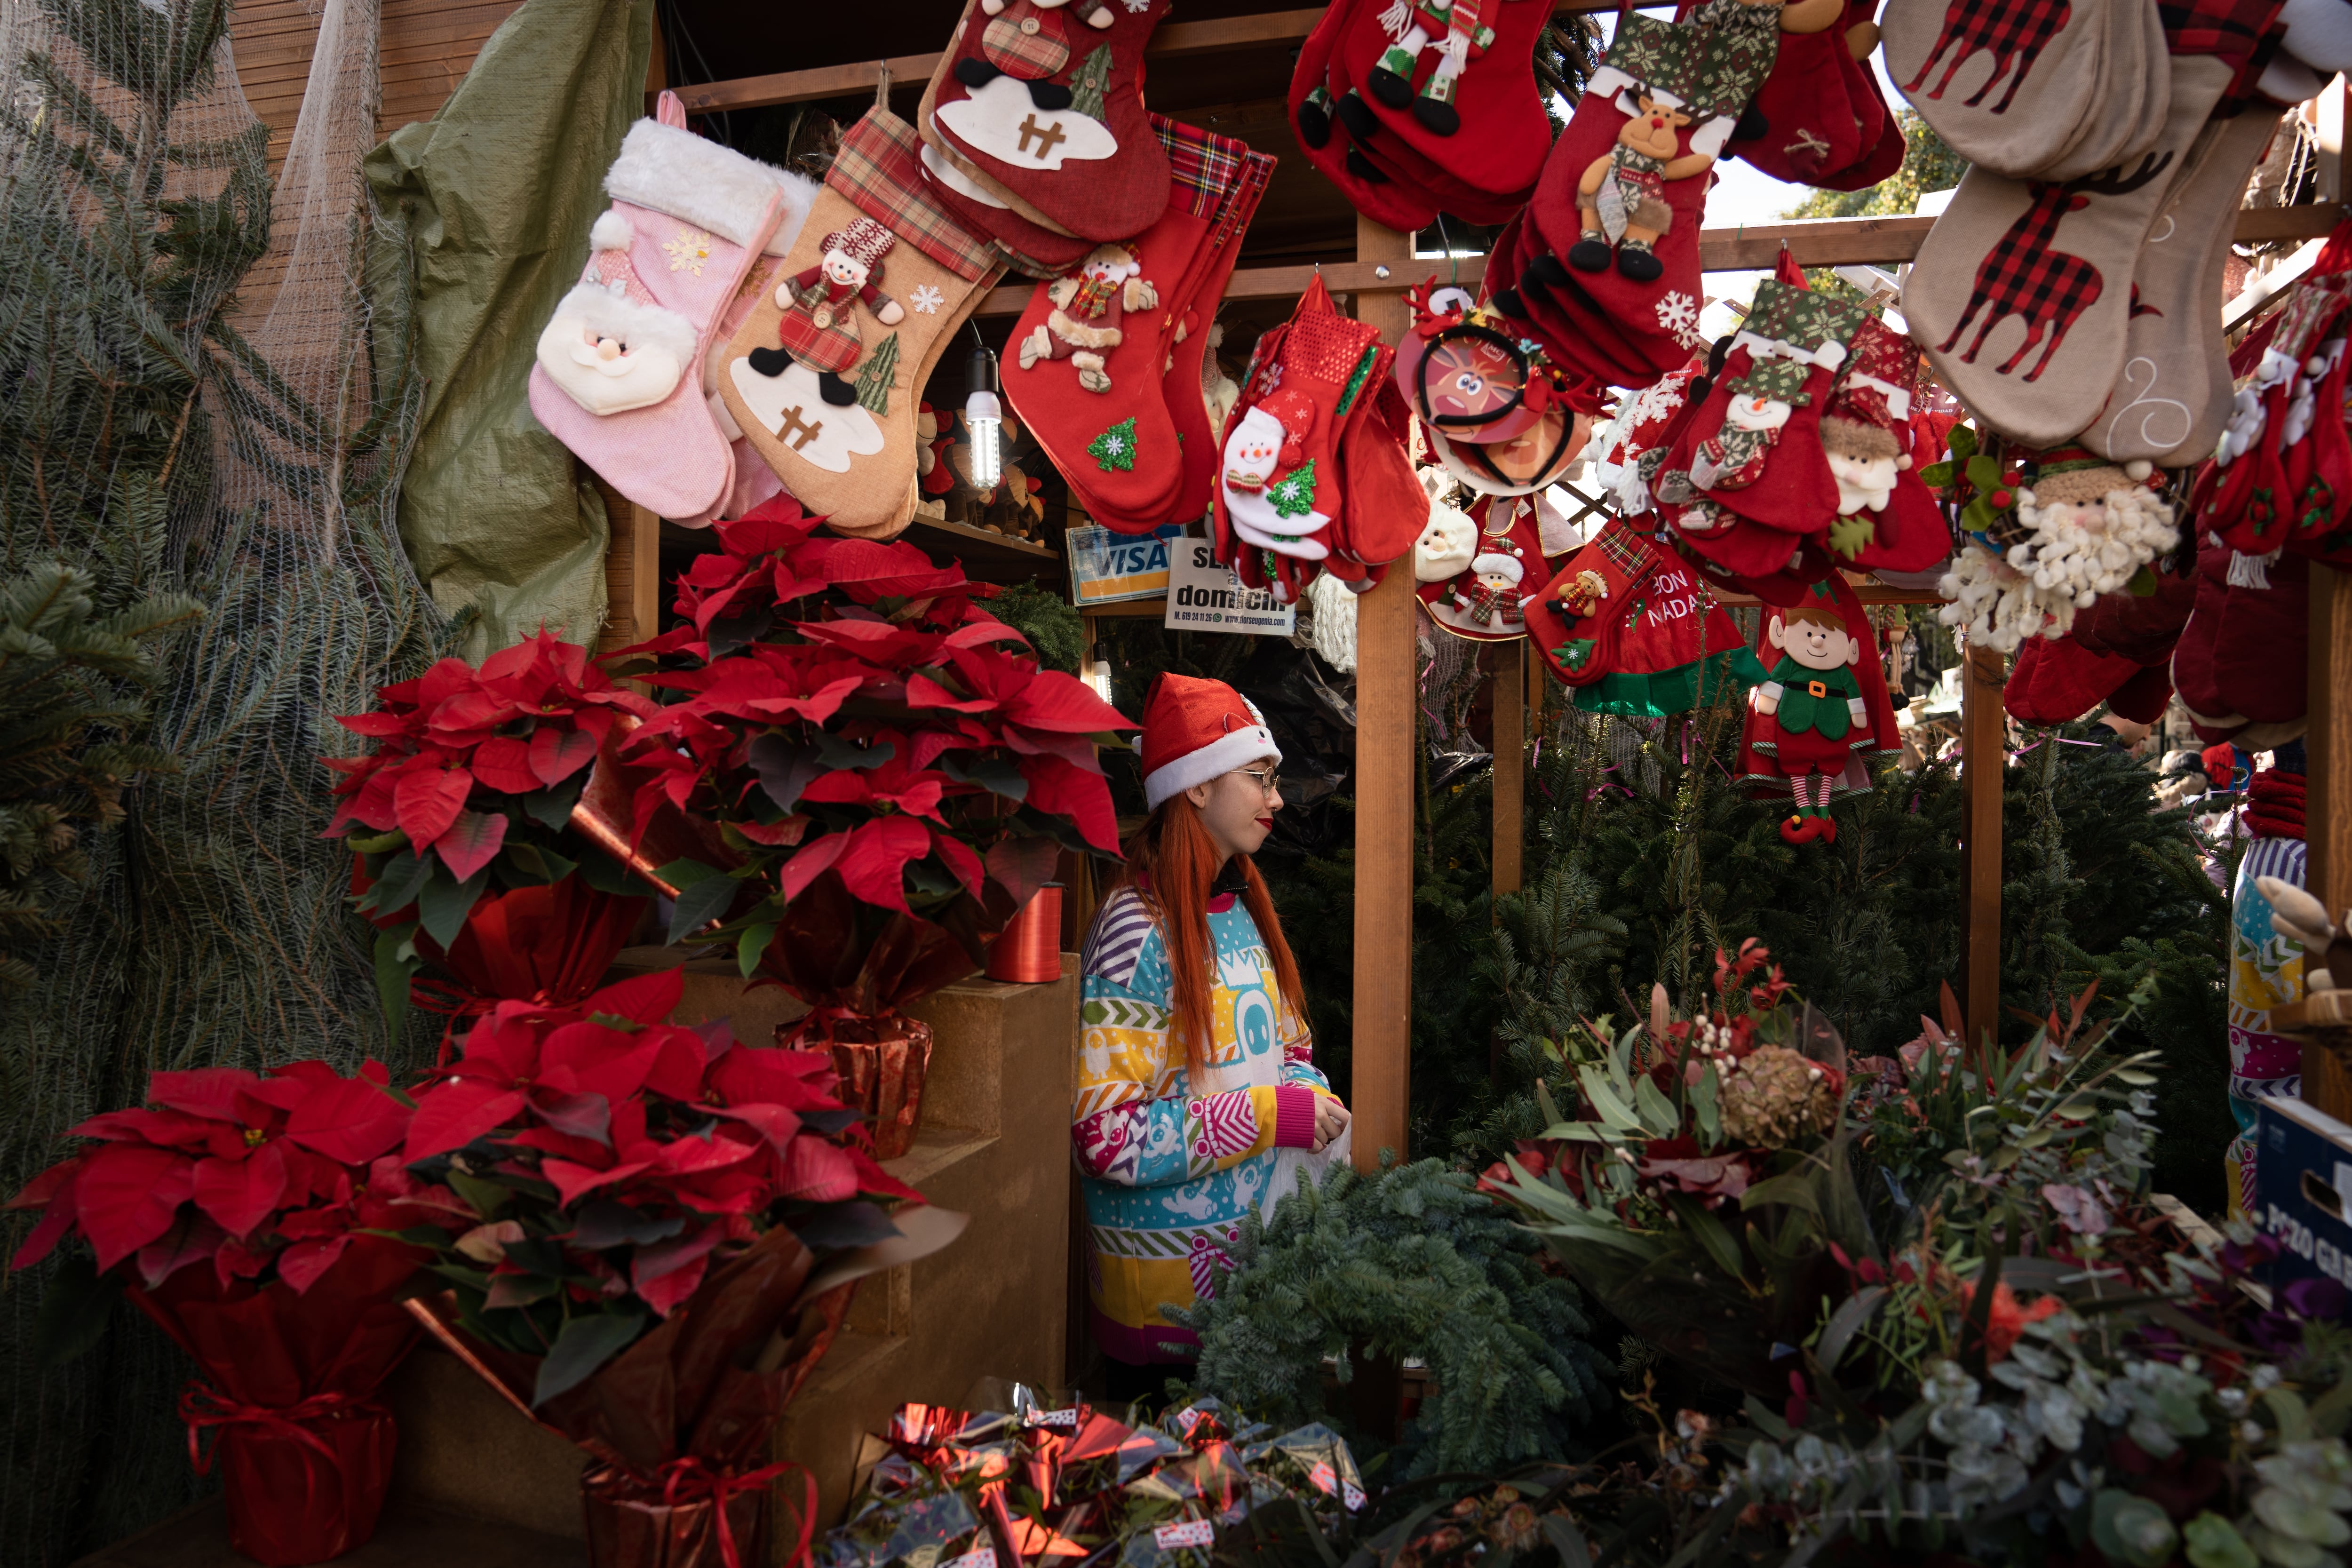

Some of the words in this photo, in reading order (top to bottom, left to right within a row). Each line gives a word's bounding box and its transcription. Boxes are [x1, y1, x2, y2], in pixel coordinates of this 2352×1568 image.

[1090, 544, 1168, 576] VISA
[1653, 570, 1688, 596] BON
[1176, 585, 1286, 612] domici
[1174, 611, 1181, 620] M.
[1182, 612, 1191, 621] 619
[1192, 612, 1199, 621] 24
[1200, 613, 1204, 621] 11
[1205, 613, 1212, 622] 26
[1225, 615, 1285, 626] www.florseugenia.com
